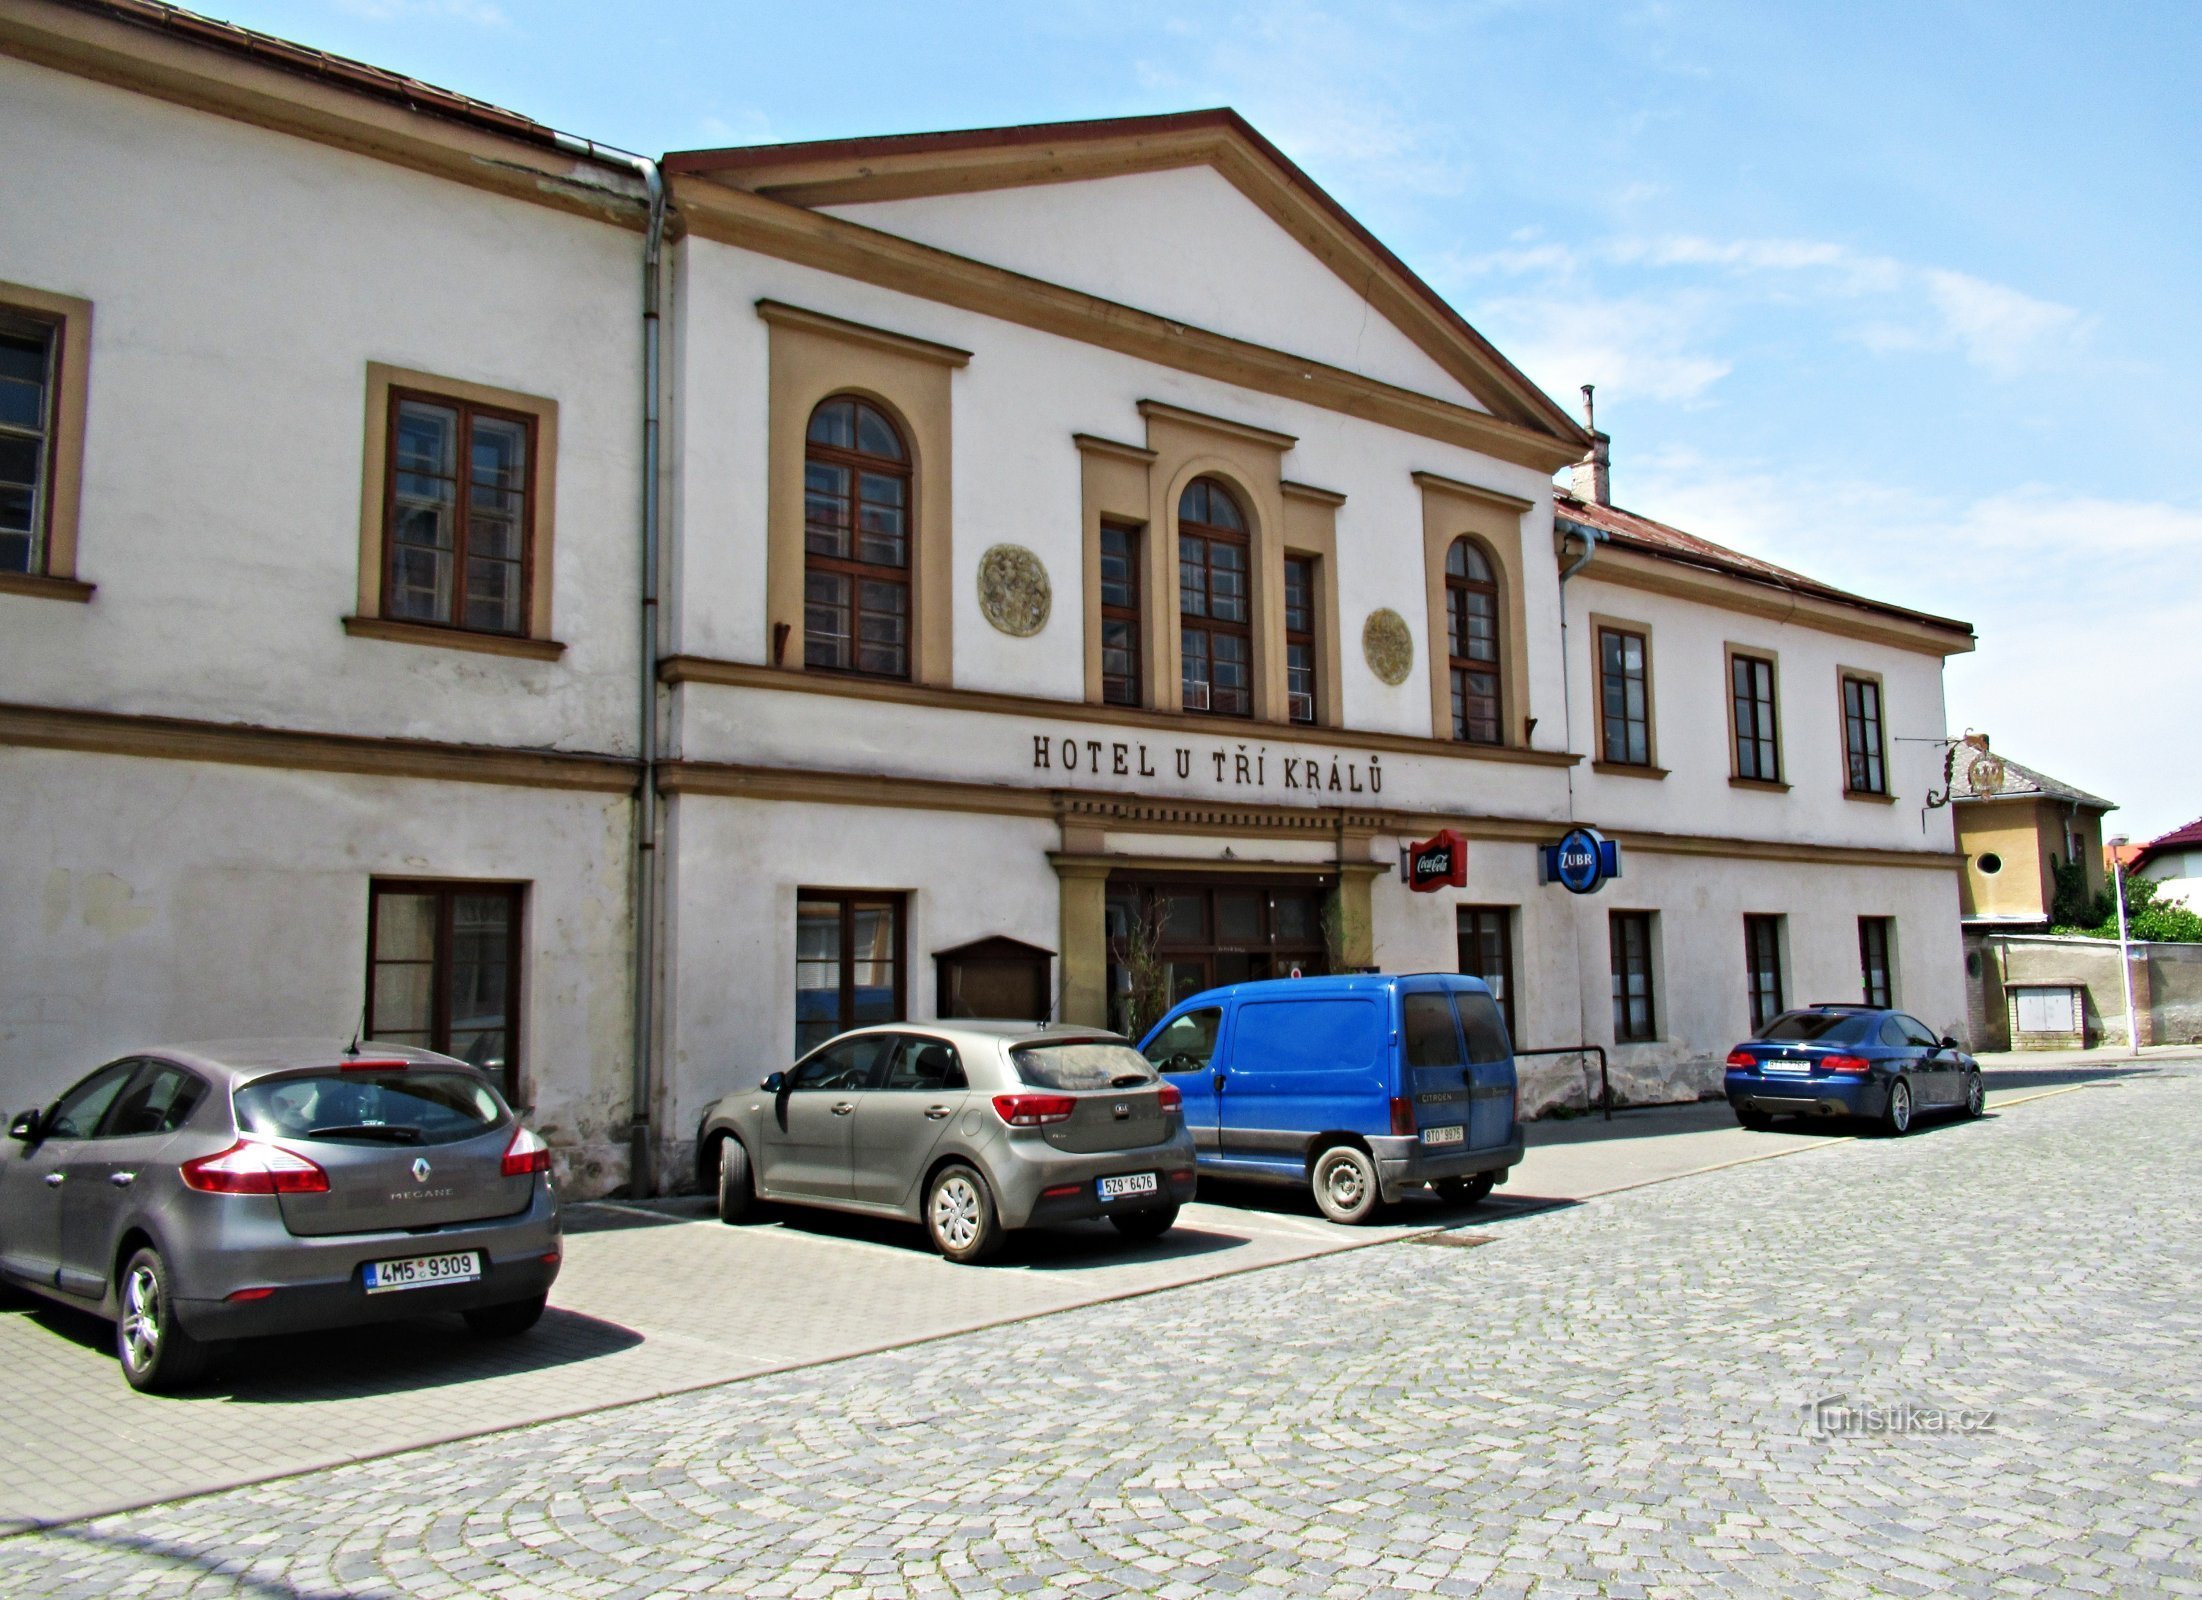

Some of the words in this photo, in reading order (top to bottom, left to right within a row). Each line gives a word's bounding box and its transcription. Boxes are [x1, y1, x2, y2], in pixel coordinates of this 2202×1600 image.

[1033, 735, 1155, 777] HOTEL
[1175, 748, 1190, 778] U
[1212, 744, 1266, 786] TŘÍ
[1284, 754, 1382, 794] KRÁLŮ
[1560, 852, 1593, 869] ZUBR
[1105, 1179, 1124, 1195] 5Z9
[1130, 1175, 1153, 1191] 6476
[381, 1261, 415, 1283] 4M5
[428, 1255, 472, 1277] 9309
